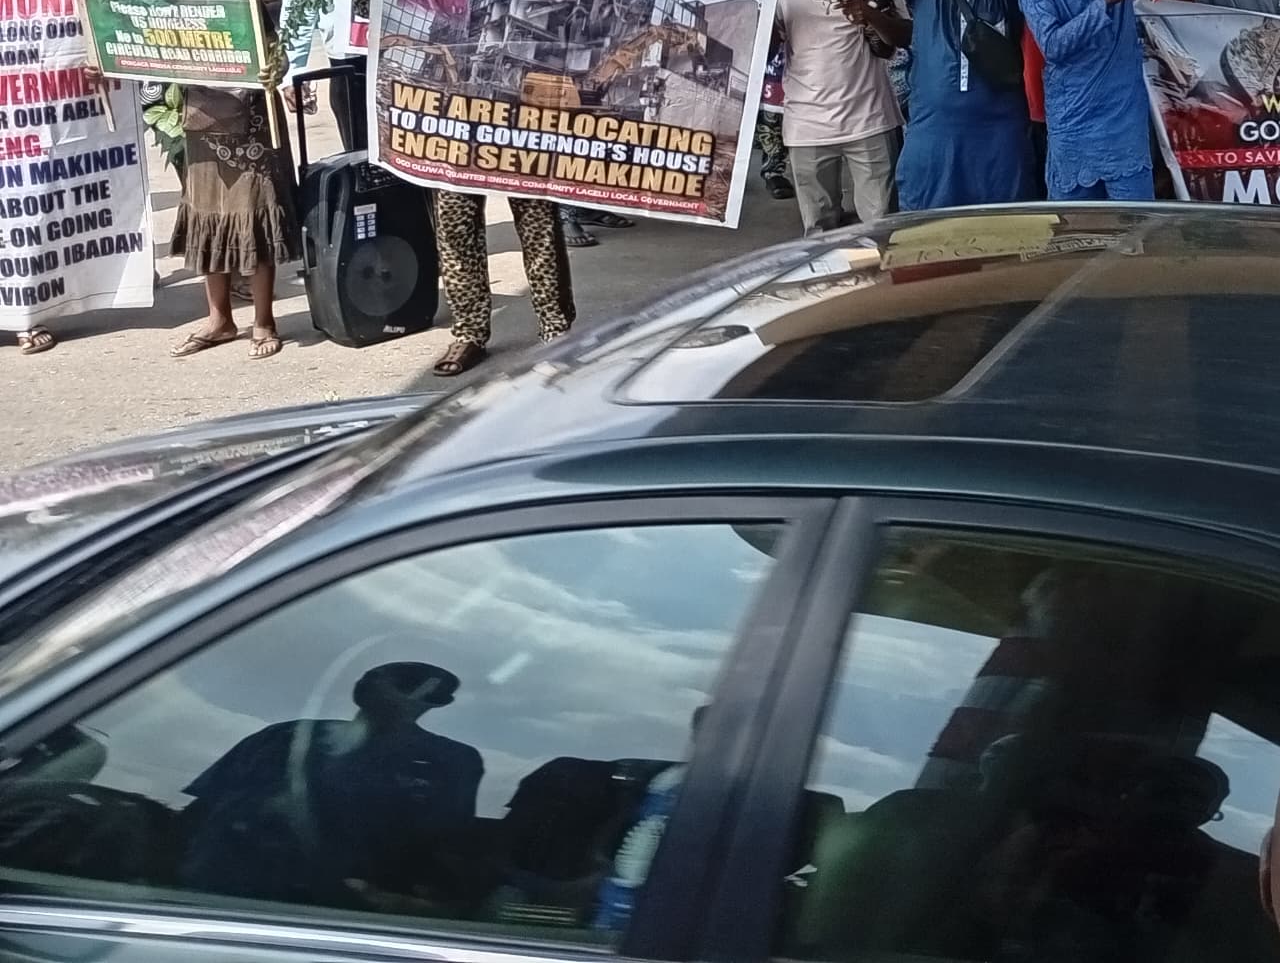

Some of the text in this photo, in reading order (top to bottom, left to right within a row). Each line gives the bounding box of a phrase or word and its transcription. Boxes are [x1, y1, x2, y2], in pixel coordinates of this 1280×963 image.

[110, 1, 148, 17] Please
[105, 41, 252, 64] CIRCULAR ROAD CORRIDOR
[143, 28, 178, 46] 500
[178, 29, 235, 50] METRE
[14, 105, 58, 129] OUR
[392, 82, 713, 156] WE ARE RELOCATING
[389, 107, 711, 174] TO OUR GOVERNOR'S HOUSE
[29, 143, 138, 185] MAKINDE
[391, 126, 705, 197] ENGR SEYI MAKINDE
[1215, 152, 1238, 164] TO
[71, 179, 111, 206] THE
[411, 163, 444, 175] OLUWA
[611, 192, 639, 203] LOCAL
[640, 195, 700, 210] GOVERNMENT
[10, 225, 42, 248] ON
[46, 208, 113, 242] GOING
[64, 232, 143, 266] IBADAN
